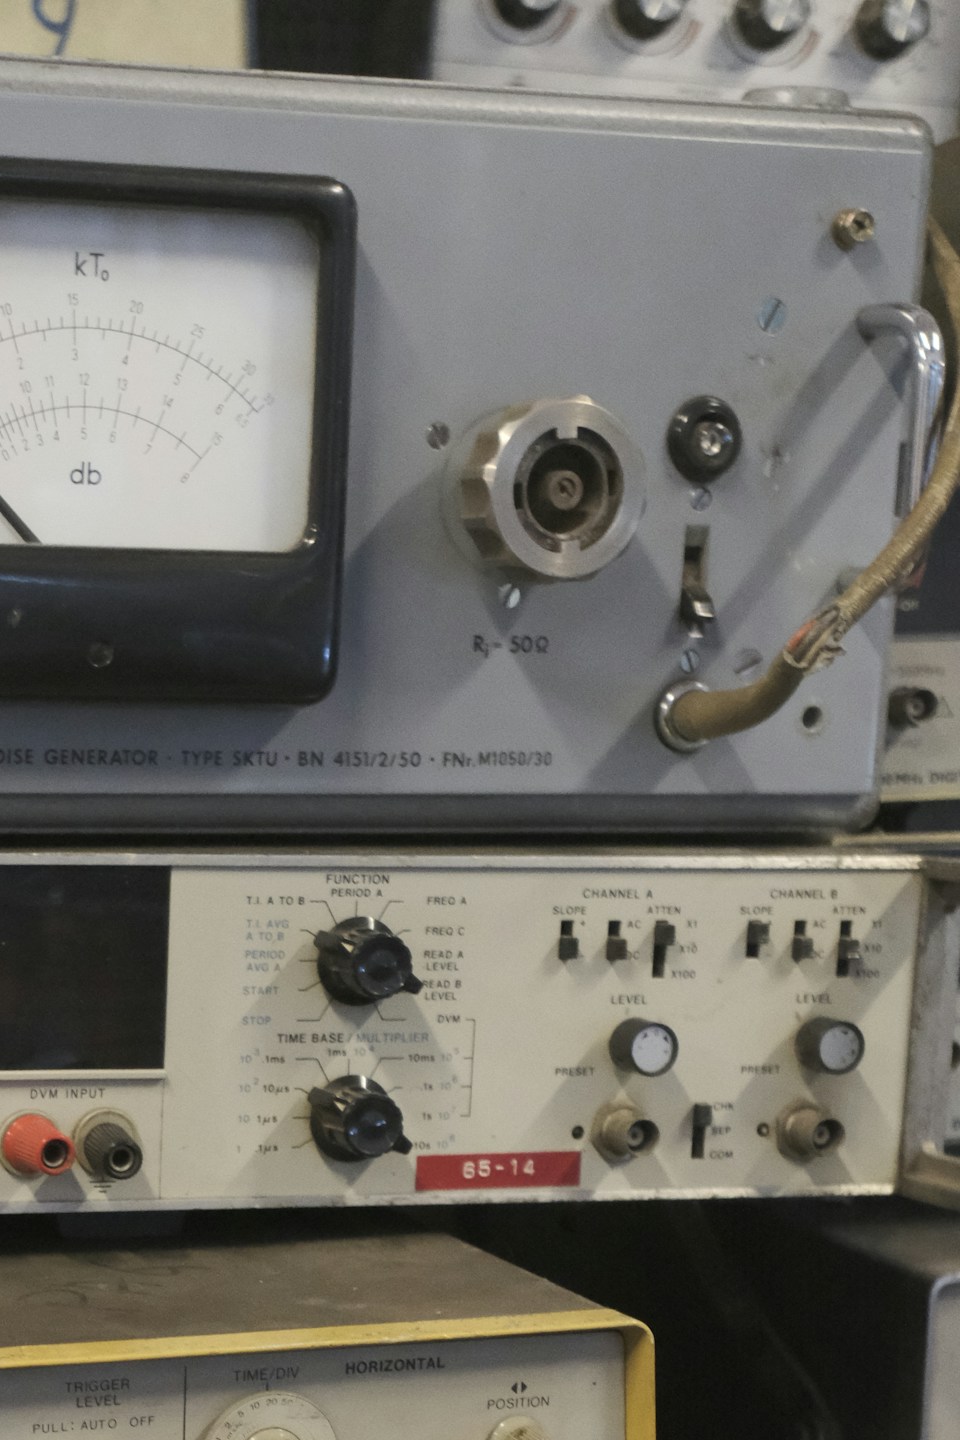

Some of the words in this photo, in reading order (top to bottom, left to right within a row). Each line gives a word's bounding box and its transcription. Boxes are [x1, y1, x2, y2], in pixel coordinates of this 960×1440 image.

[69, 461, 102, 486] db
[44, 749, 158, 767] GENERATOR
[181, 750, 223, 767] TYPE
[233, 750, 278, 768] SKTU
[297, 751, 324, 767] BN
[326, 874, 390, 885] FUNCTION
[331, 888, 371, 898] PERIOD
[582, 888, 639, 899] CHANNEL
[770, 888, 825, 899] CHANNEL
[437, 1015, 461, 1024] DVM
[555, 1067, 595, 1077] PRESET
[741, 1065, 781, 1076] PRESET
[30, 1088, 58, 1100] DVM
[66, 1087, 107, 1099] INPUT
[345, 1357, 445, 1375] HORIZONTAL
[234, 1366, 300, 1382] TIME/DIV
[66, 1378, 130, 1393] TRIGGER
[76, 1394, 120, 1408] LEVEL
[487, 1396, 550, 1410] POSITION
[81, 1418, 118, 1431] AUTO
[130, 1415, 155, 1428] OFF
